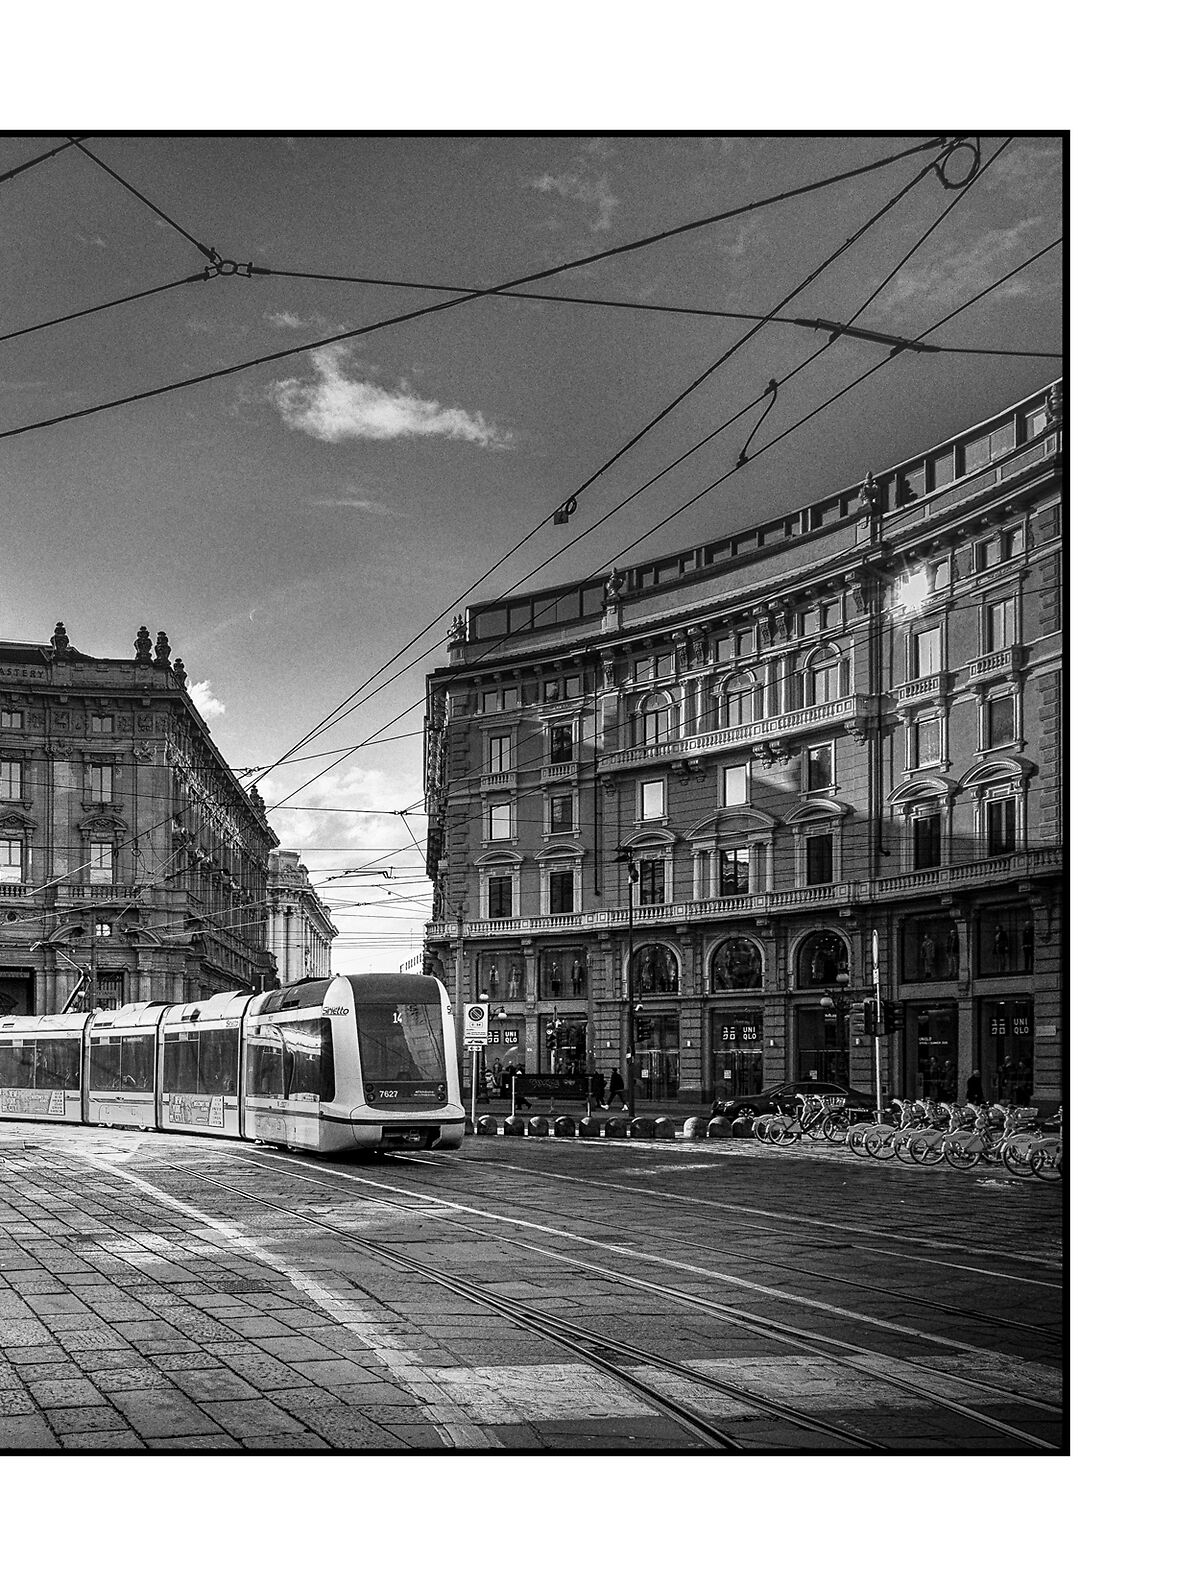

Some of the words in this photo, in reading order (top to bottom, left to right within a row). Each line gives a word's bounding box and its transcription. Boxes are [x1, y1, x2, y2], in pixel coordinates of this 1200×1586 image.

[392, 1012, 402, 1023] 14
[1013, 1018, 1028, 1026] UNI
[1013, 1026, 1029, 1035] QLO
[379, 1090, 399, 1098] 7627
